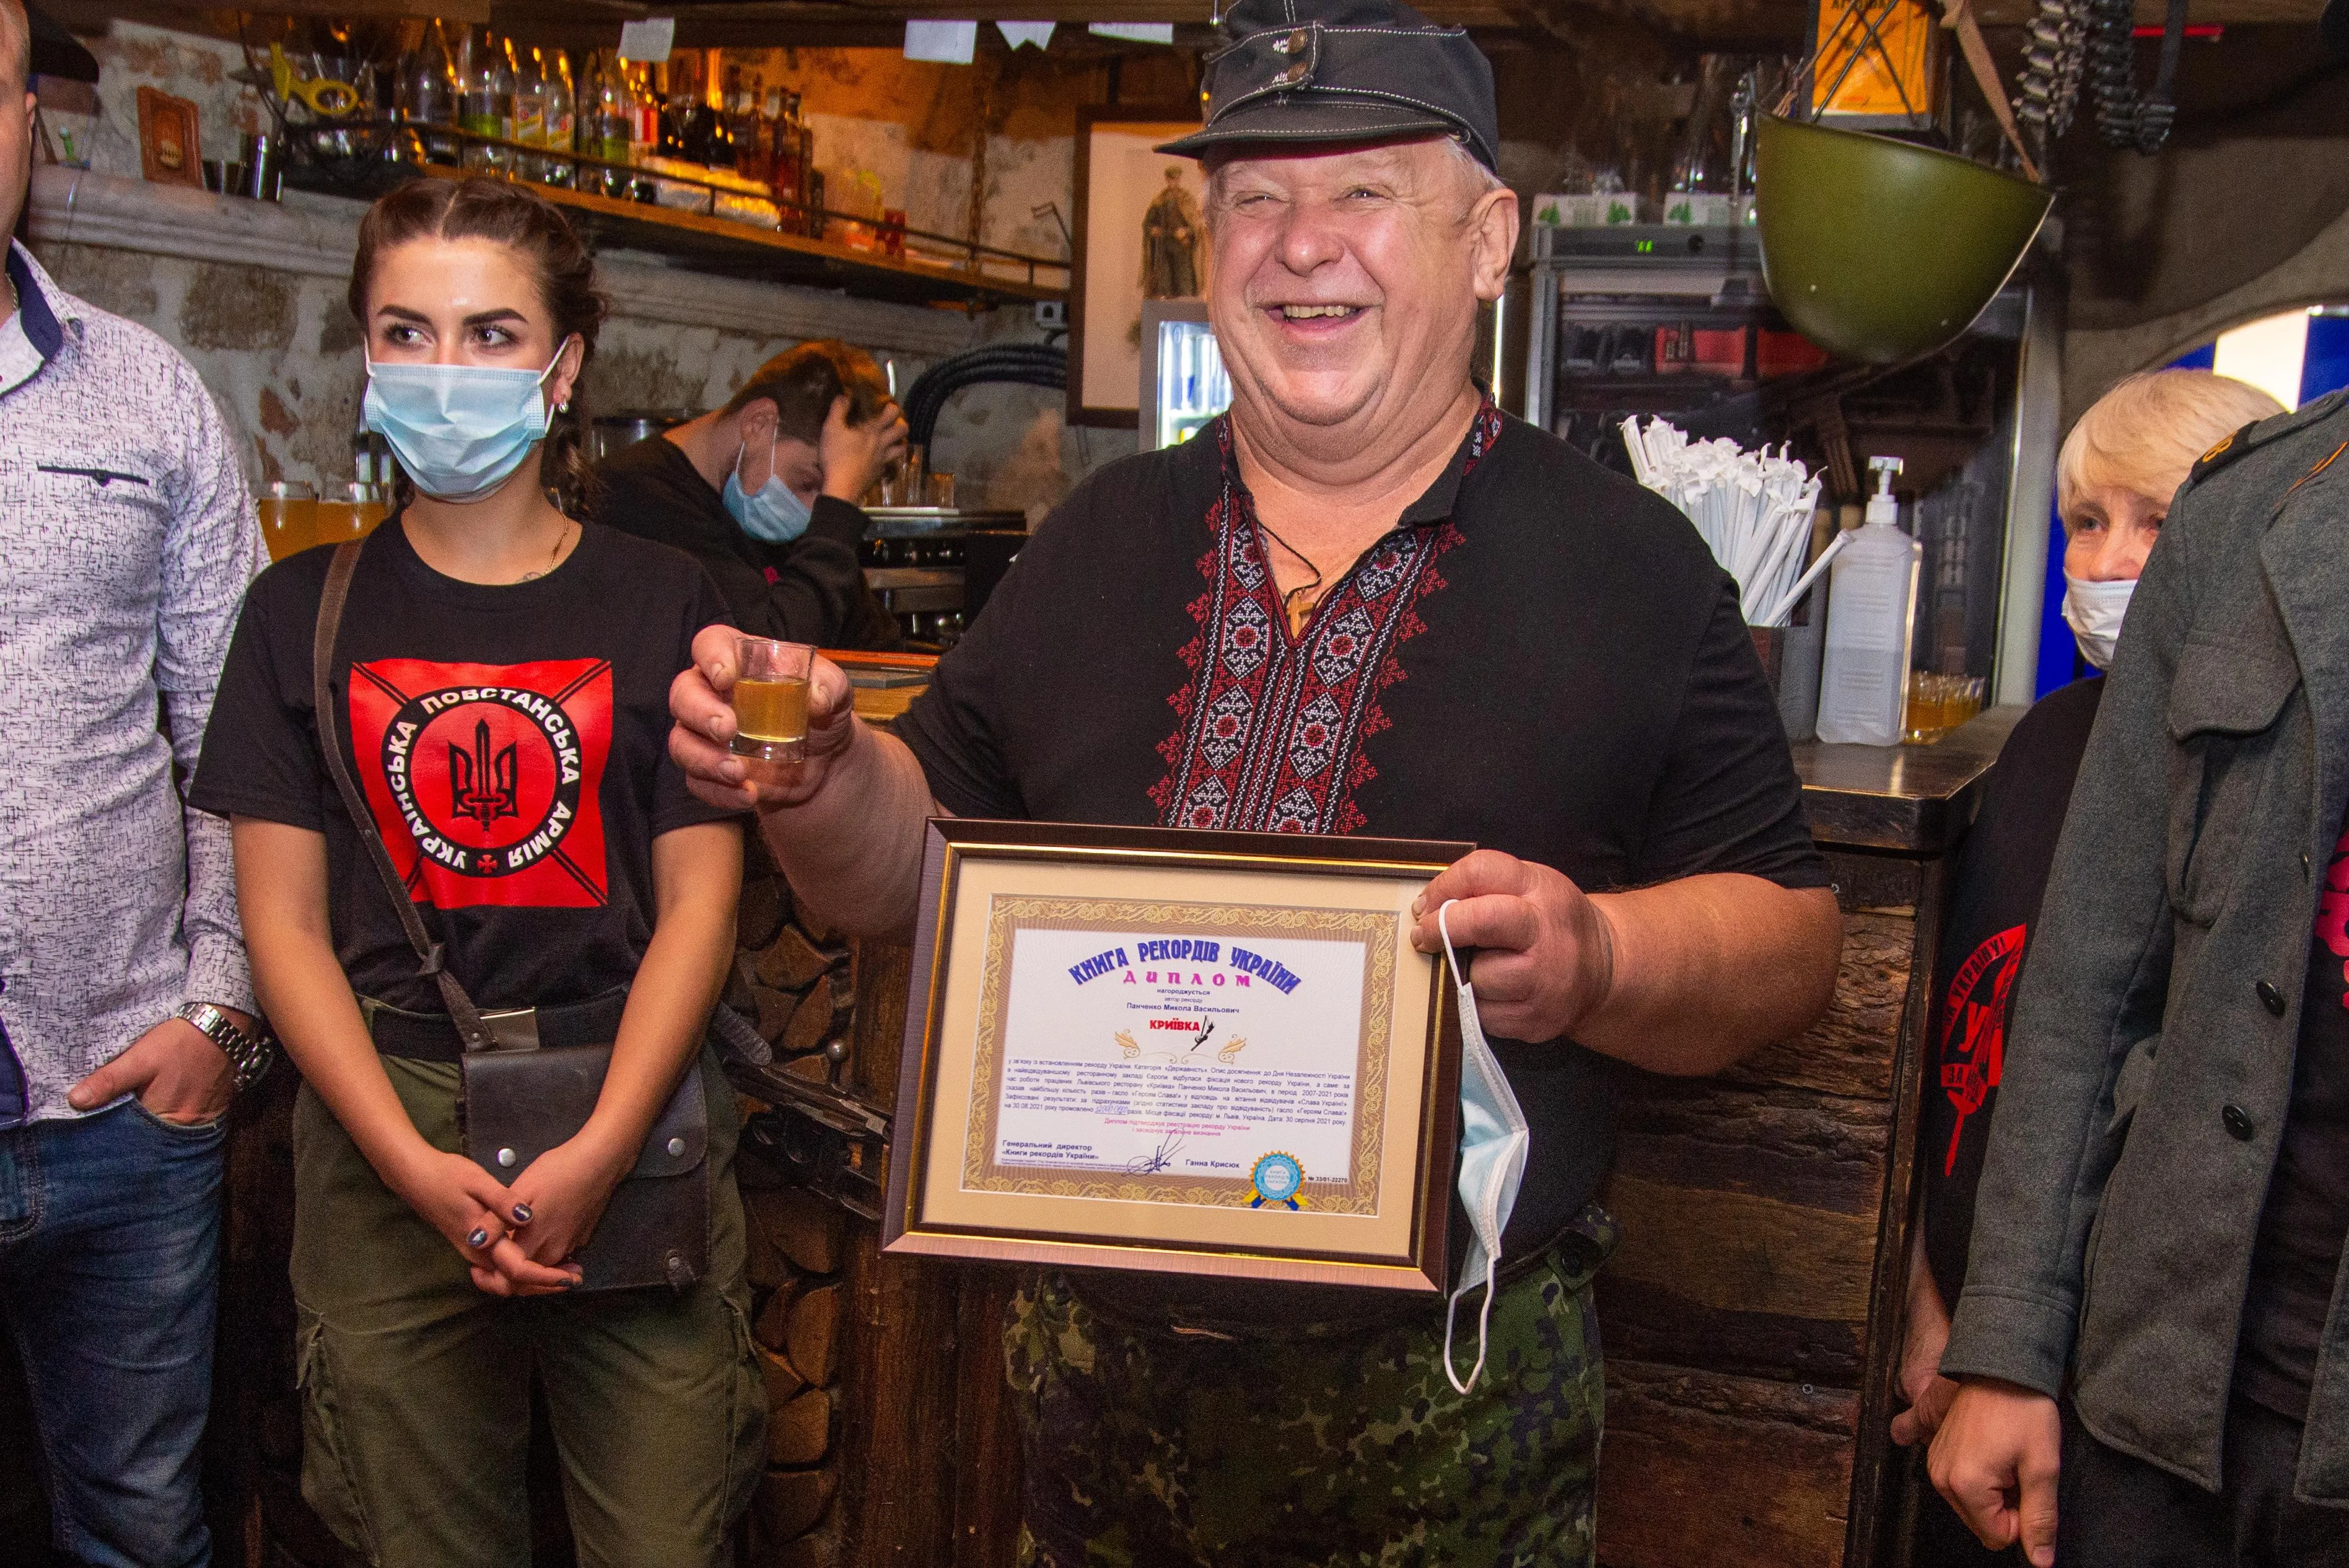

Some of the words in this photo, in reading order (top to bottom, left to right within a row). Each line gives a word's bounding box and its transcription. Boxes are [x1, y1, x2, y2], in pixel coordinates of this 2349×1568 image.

[420, 688, 580, 784] ПОВСТАНСЬКА
[507, 800, 572, 869] АРМІЯ
[1068, 947, 1130, 986] КНИГА
[1137, 939, 1220, 963] РЕКОРДІВ
[1229, 947, 1302, 996] УКРАЇНИ
[1194, 1005, 1240, 1014] Васильович
[1150, 1017, 1201, 1031] КРИЇВКА
[1134, 1063, 1162, 1072] Категорія
[1272, 1069, 1284, 1077] Дня
[1286, 1070, 1326, 1078] Незалежності
[1327, 1072, 1350, 1080] України
[1146, 1073, 1168, 1081] Європи
[1173, 1074, 1202, 1082] відбулася
[1020, 1075, 1039, 1084] роботи
[1178, 1083, 1206, 1091] Панченко
[1002, 1139, 1052, 1149] Генеральний
[1030, 1150, 1063, 1158] рекордів
[1065, 1152, 1099, 1160] України»
[1210, 1160, 1240, 1168] Крисюк
